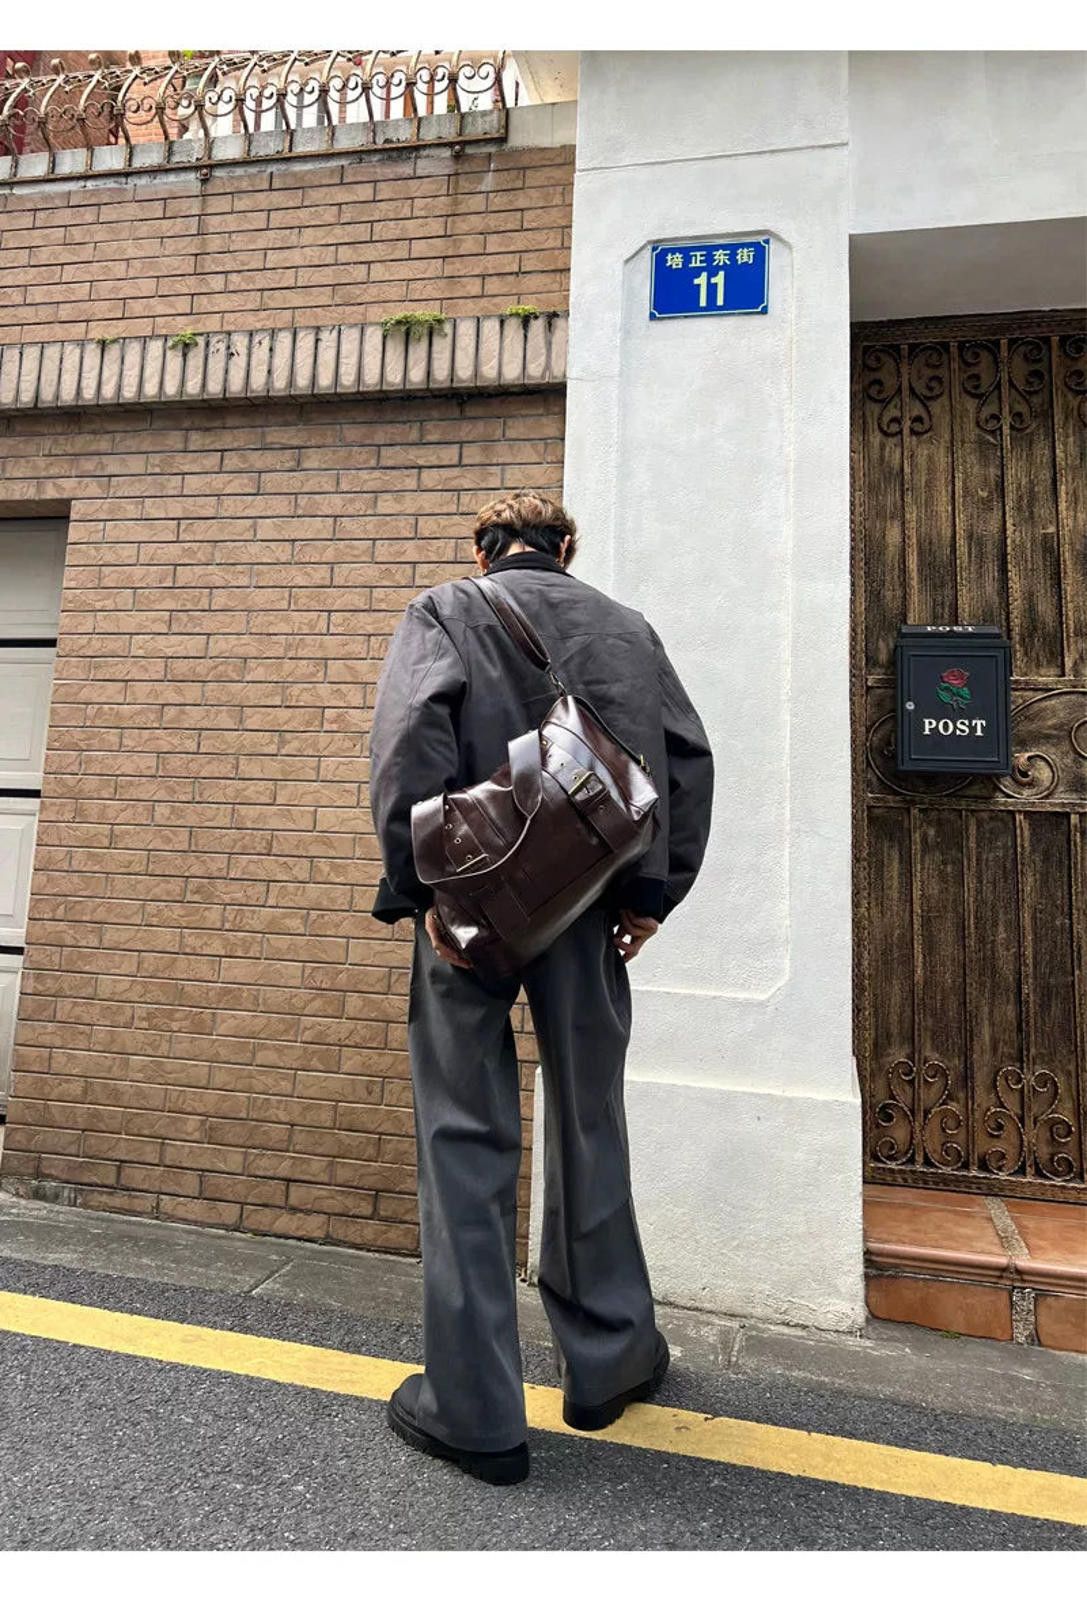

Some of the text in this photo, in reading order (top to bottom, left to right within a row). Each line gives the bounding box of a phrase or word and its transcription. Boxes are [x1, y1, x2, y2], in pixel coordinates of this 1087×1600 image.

[665, 248, 755, 269] 培正东街
[693, 271, 725, 307] 11
[922, 718, 986, 736] POST
